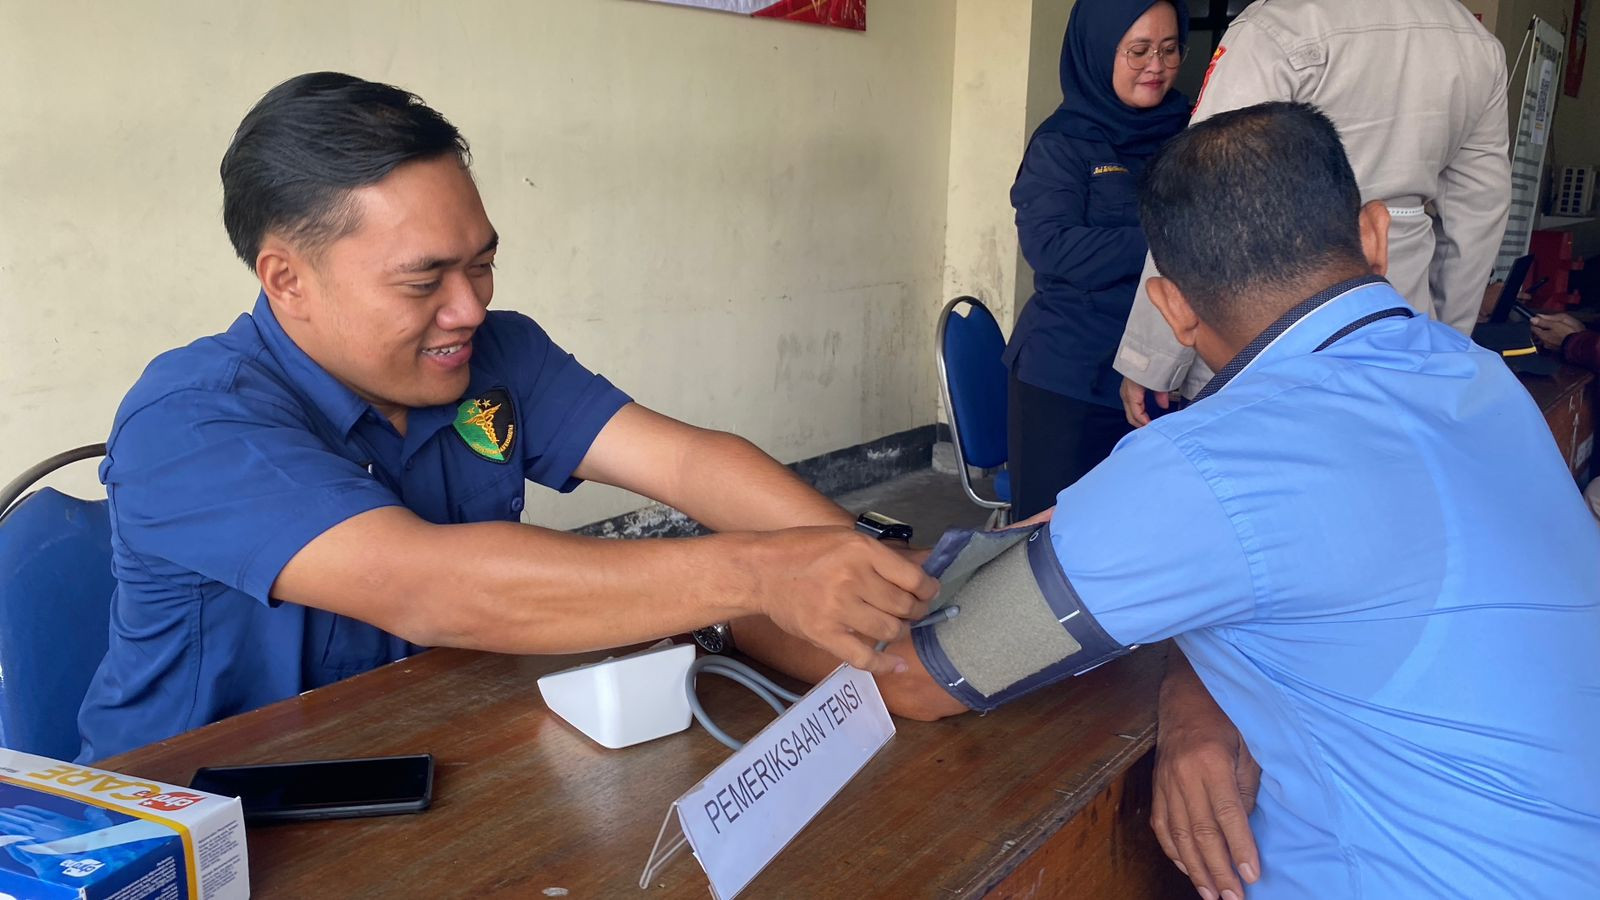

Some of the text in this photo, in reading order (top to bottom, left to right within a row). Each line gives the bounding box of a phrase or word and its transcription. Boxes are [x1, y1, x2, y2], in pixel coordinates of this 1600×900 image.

[27, 765, 162, 800] CARE
[704, 680, 863, 834] PEMERIKSAAN TENSI
